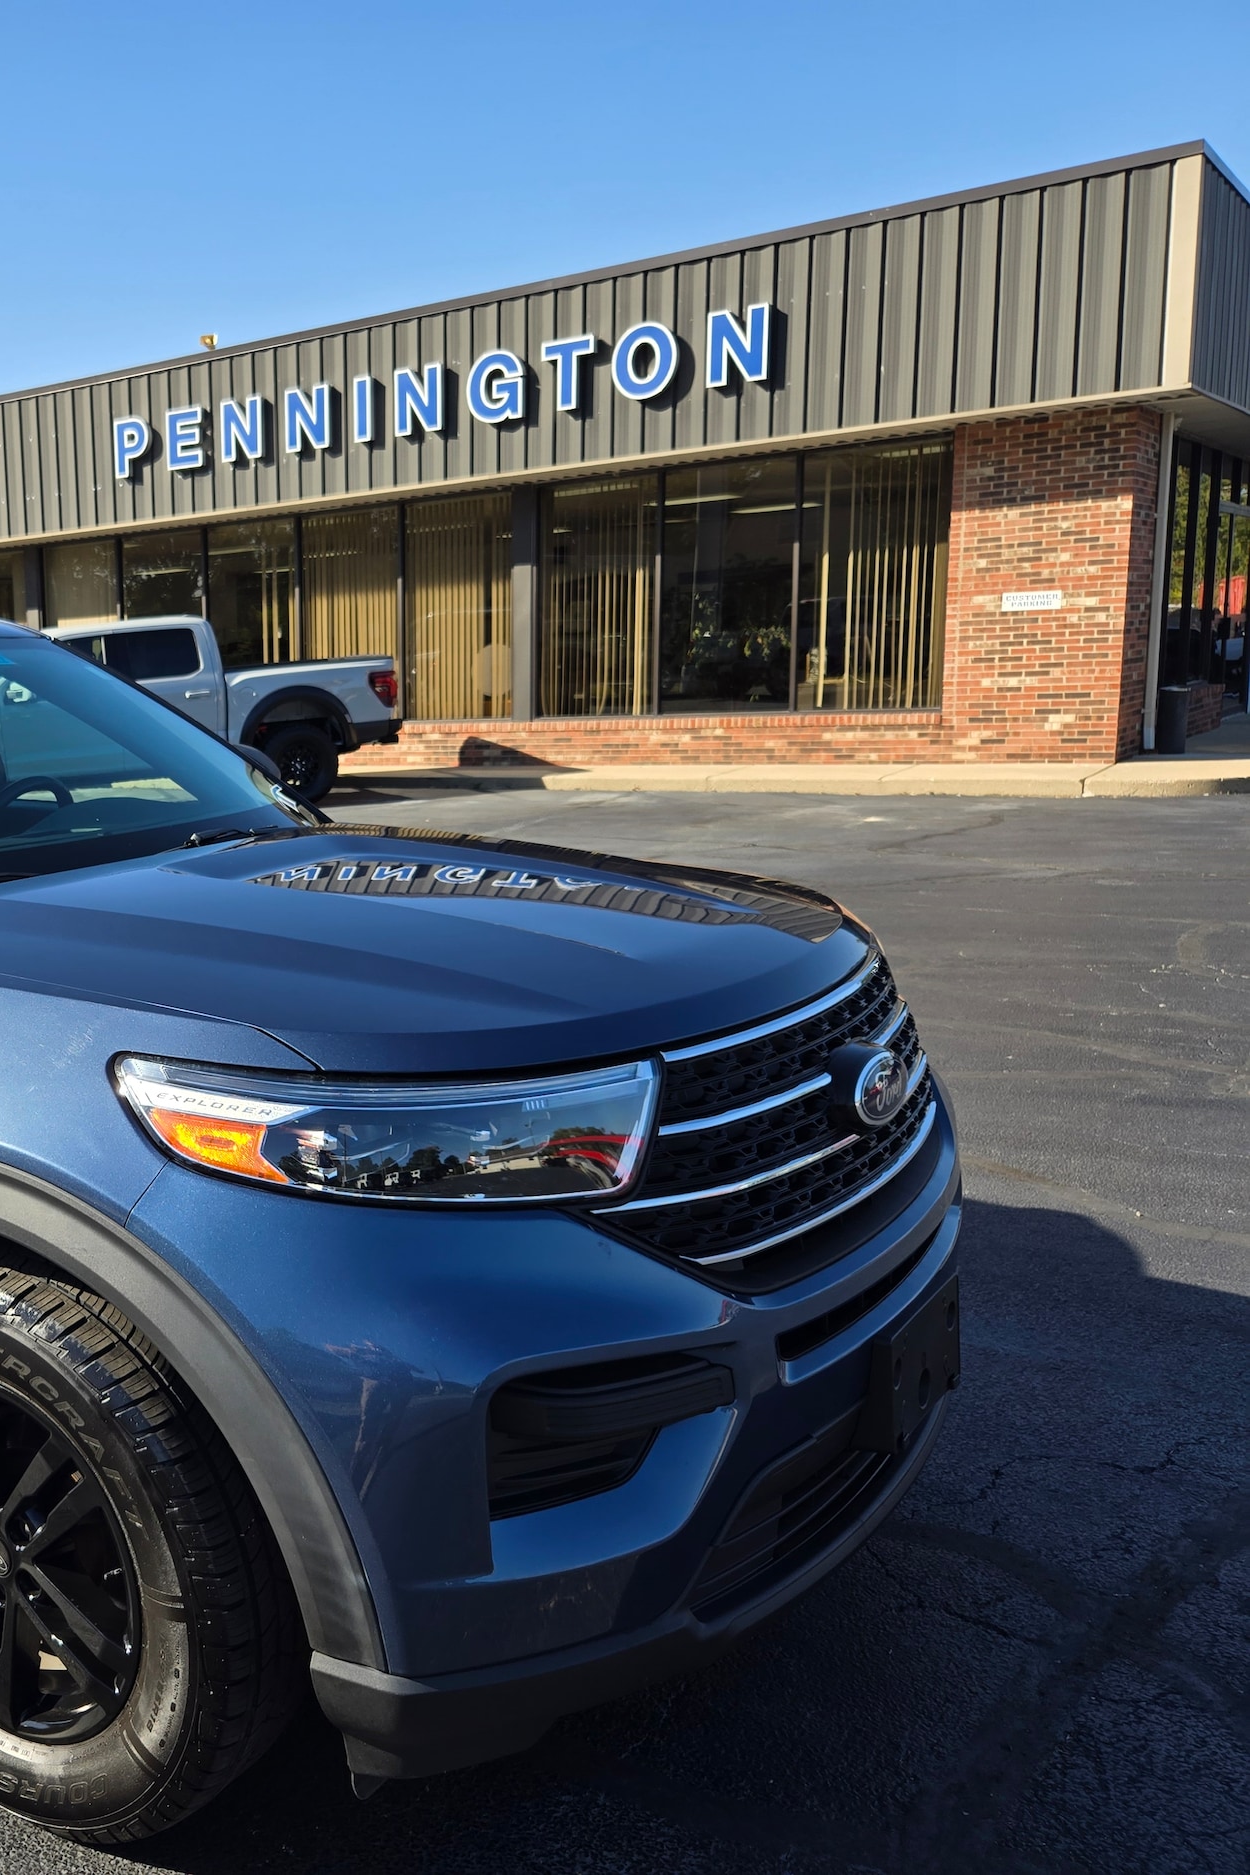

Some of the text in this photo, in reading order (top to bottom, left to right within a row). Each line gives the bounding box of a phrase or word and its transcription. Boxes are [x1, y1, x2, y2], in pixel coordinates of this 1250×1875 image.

[112, 301, 772, 480] PENNINGTON
[1006, 593, 1058, 601] CUSTOMER
[156, 1091, 273, 1117] EXPLORER
